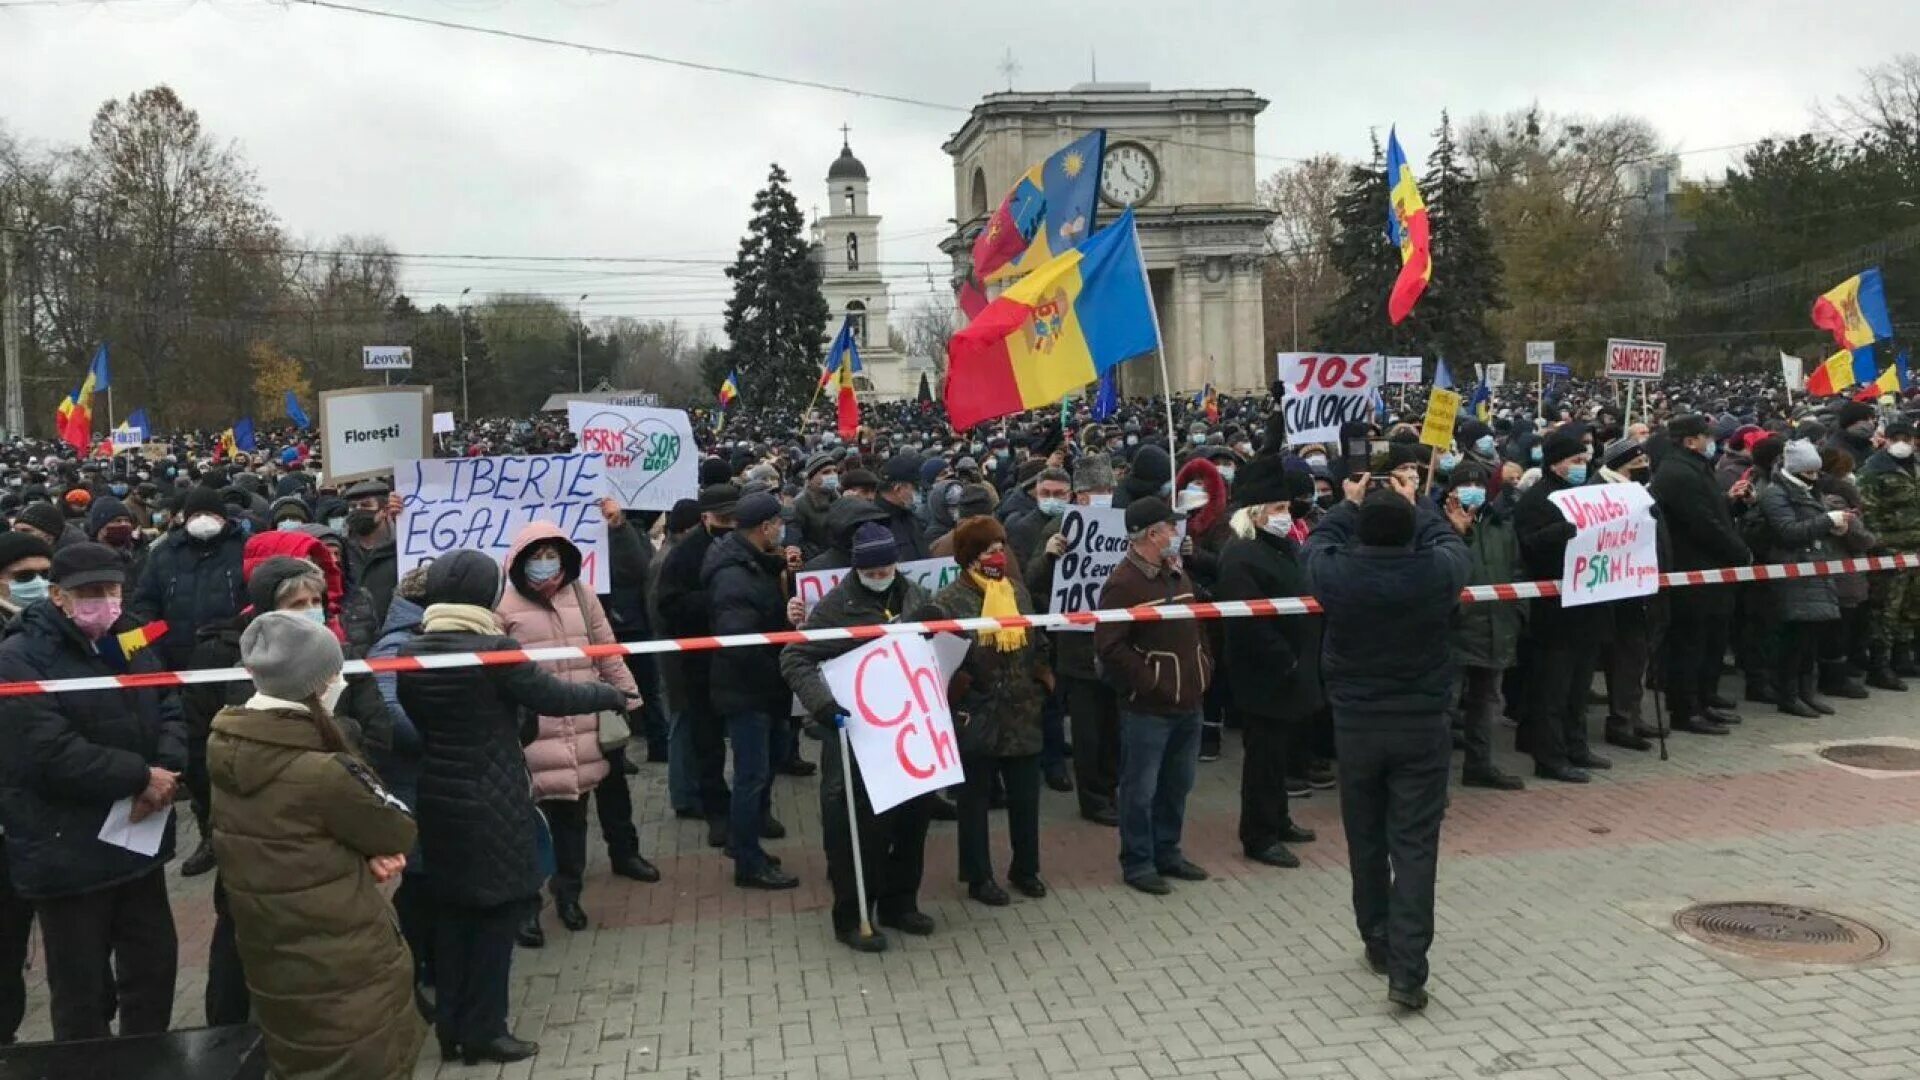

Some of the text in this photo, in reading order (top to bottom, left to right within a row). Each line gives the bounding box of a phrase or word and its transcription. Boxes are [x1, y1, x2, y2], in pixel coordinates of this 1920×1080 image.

[1295, 356, 1371, 393] JOS
[583, 427, 624, 453] PSRM
[404, 452, 603, 508] LIBERTE
